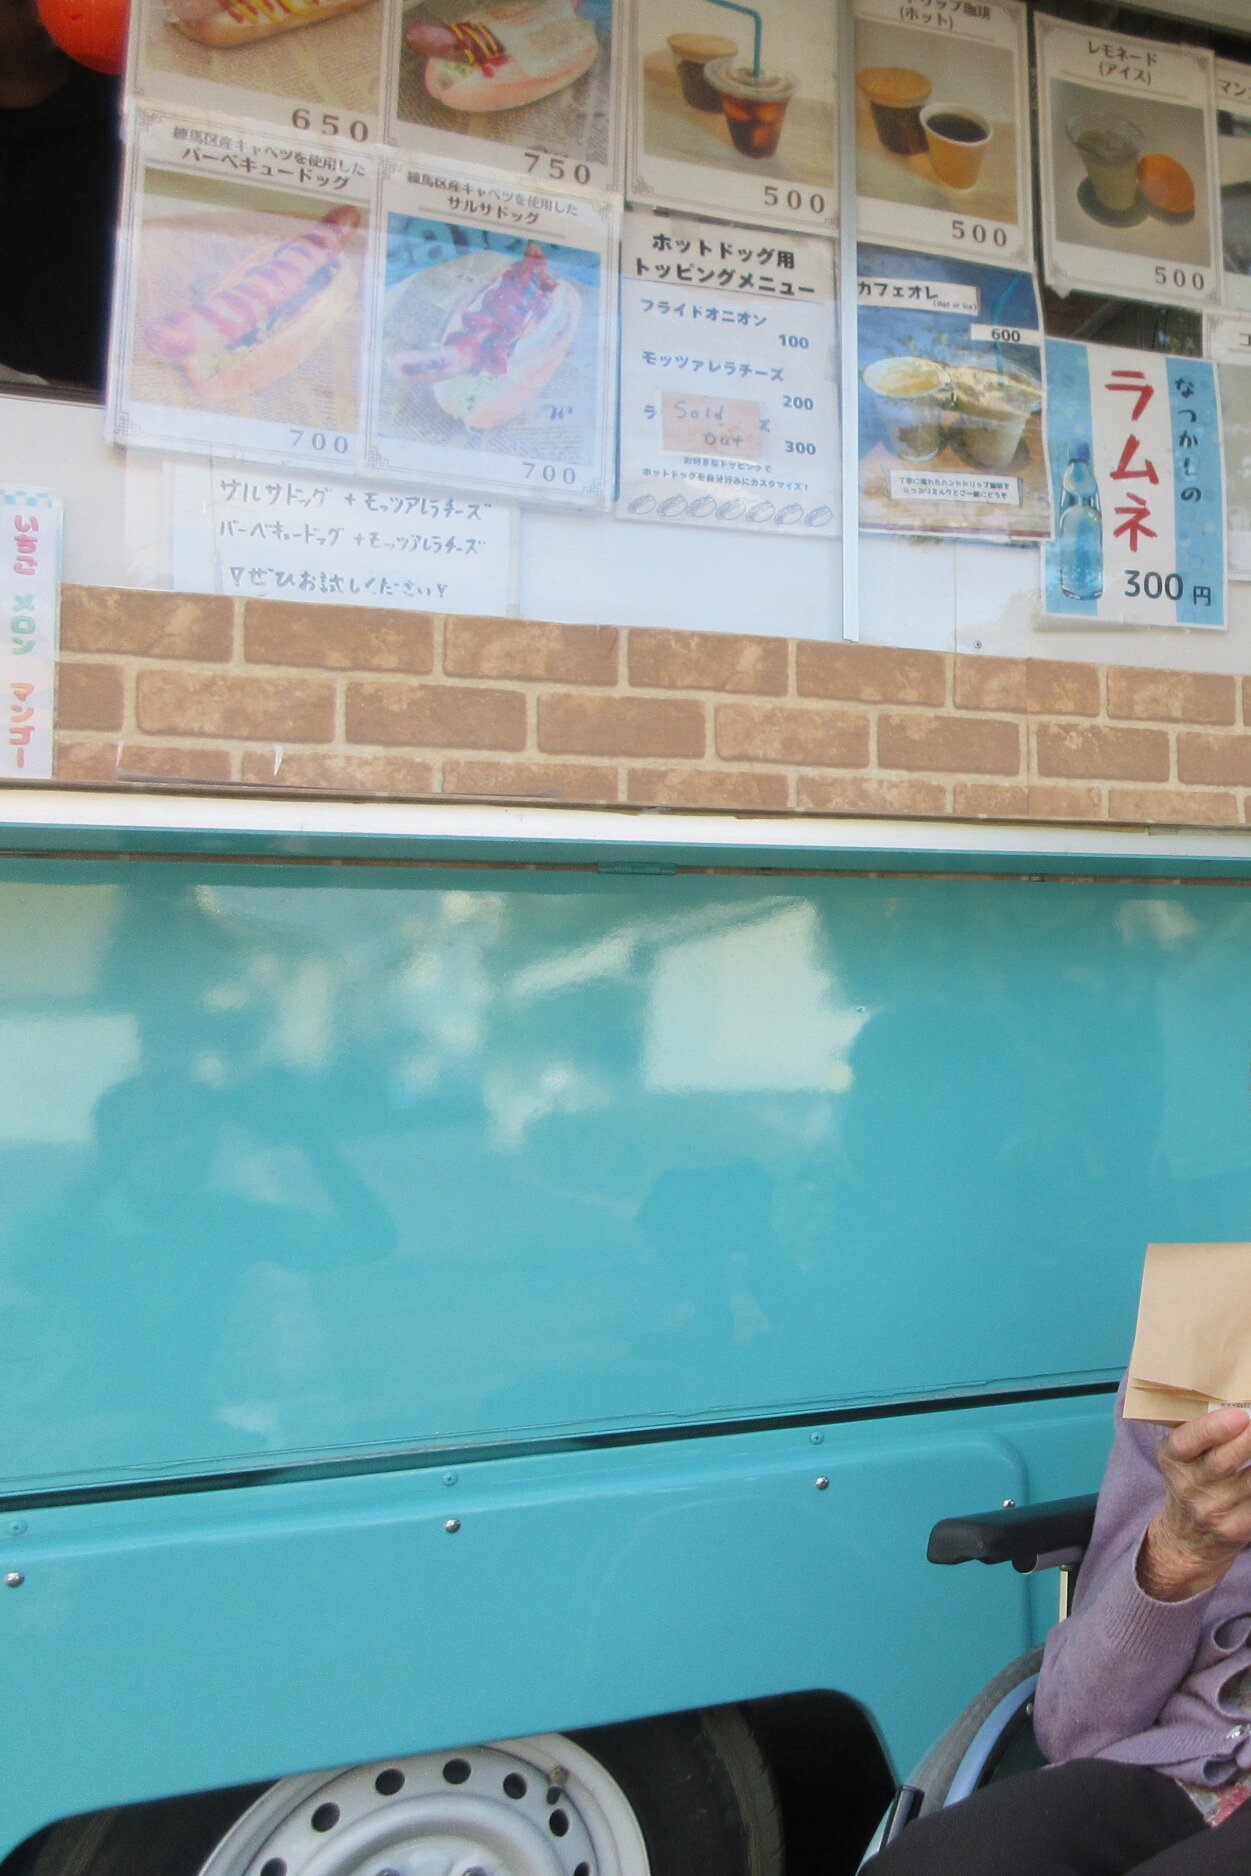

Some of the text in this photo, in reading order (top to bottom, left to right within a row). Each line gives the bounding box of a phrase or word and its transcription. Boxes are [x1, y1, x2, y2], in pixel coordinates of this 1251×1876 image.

[1088, 41, 1157, 66] レモネード
[1098, 62, 1152, 85] (アイス)
[291, 108, 369, 142] 650
[182, 148, 350, 190] バーベキュードッグ
[524, 152, 591, 185] 750
[448, 196, 540, 225] サルサドッグ
[764, 186, 825, 213] 500
[952, 220, 1007, 248] 500
[652, 233, 795, 270] ホットドッグ用
[636, 257, 815, 296] トッピングメニュー
[1155, 266, 1205, 291] 500
[858, 281, 938, 300] カフェオレ
[640, 299, 767, 326] フライドオニオン
[778, 334, 809, 349] 100
[991, 328, 1020, 343] 600
[641, 351, 785, 382] モッツァレラチーズ
[674, 400, 724, 421] Sold
[783, 395, 814, 411] 200
[289, 430, 349, 454] 700
[784, 440, 816, 455] 300
[1175, 377, 1201, 502] なつかしの
[522, 463, 576, 485] 700
[1104, 370, 1159, 552] ラムネ
[220, 480, 332, 508] サルサドッグ
[11, 594, 36, 655] メロン
[9, 683, 35, 768] マンゴー
